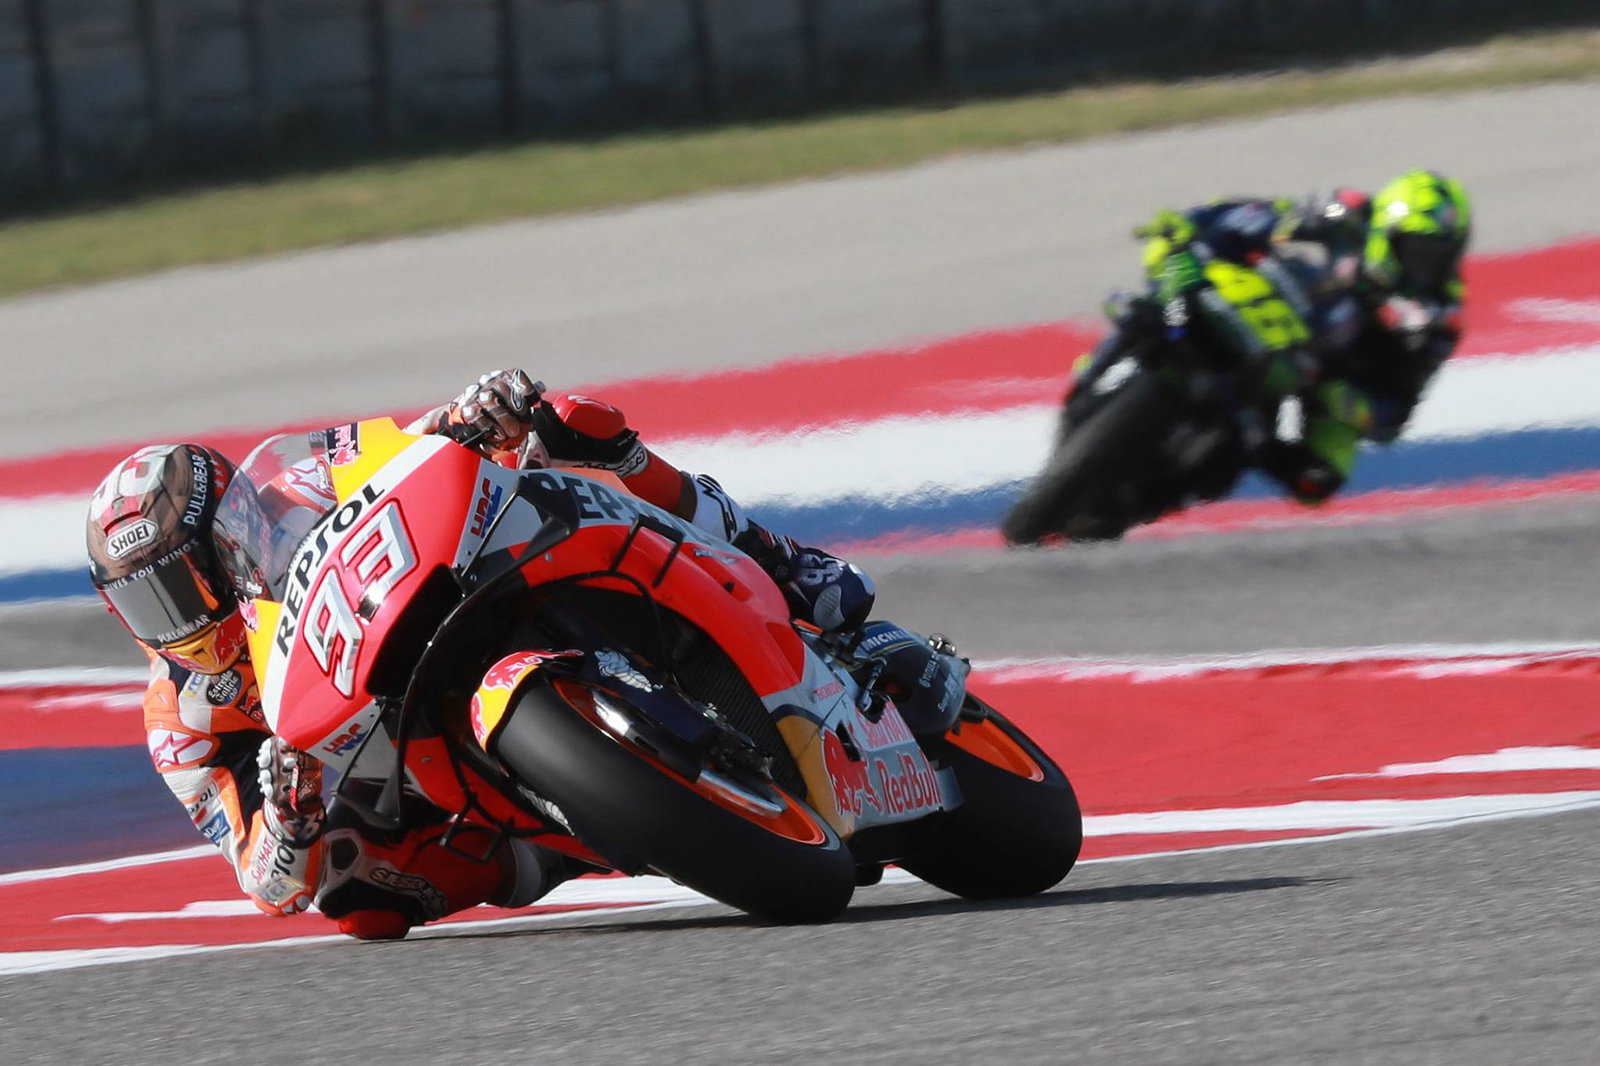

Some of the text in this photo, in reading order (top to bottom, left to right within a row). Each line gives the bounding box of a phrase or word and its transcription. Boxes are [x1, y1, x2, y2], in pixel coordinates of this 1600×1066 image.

[182, 453, 205, 526] PULL&BEAR
[110, 525, 149, 554] SHOEI
[131, 565, 154, 582] YOU
[276, 484, 386, 658] REPSOL
[303, 497, 421, 699] 93
[207, 670, 233, 700] Estrella
[905, 752, 944, 811] Bull
